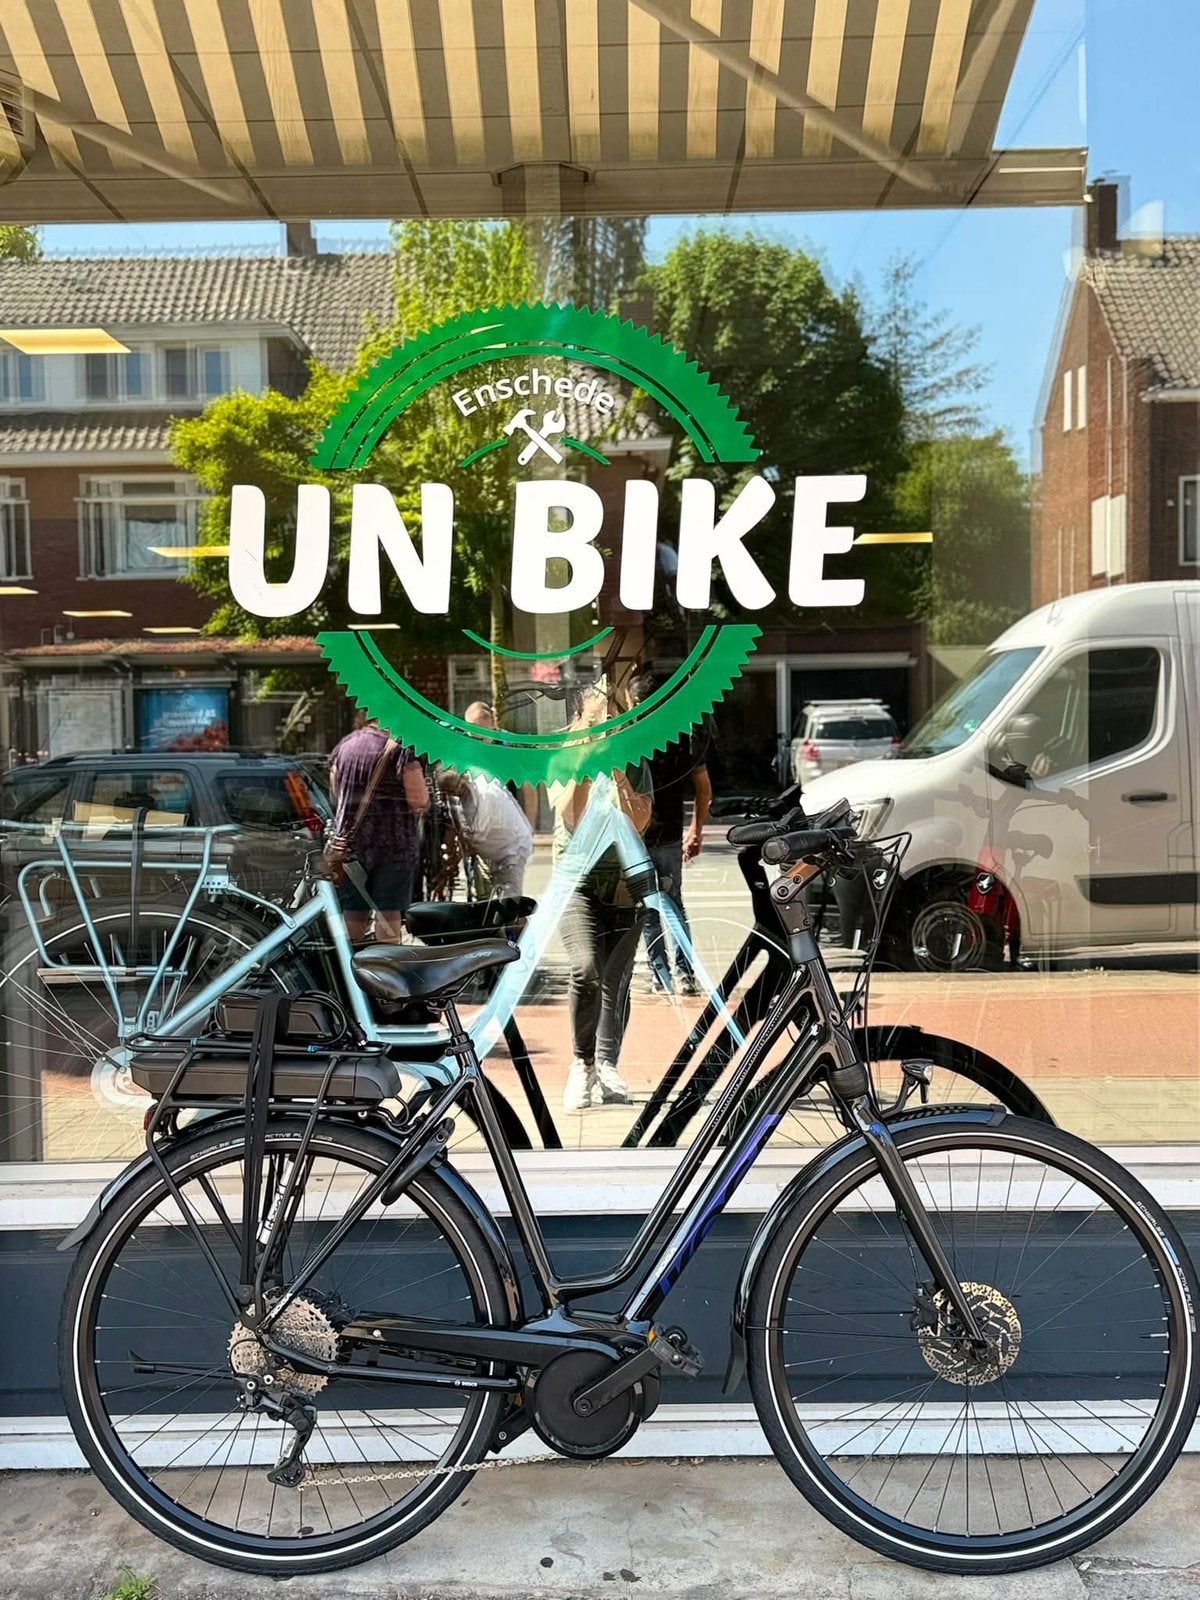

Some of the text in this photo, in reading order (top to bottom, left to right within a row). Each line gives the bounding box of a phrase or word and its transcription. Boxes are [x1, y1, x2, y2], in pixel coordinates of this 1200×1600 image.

[452, 367, 615, 417] Enschede
[228, 473, 869, 619] UN BIKE
